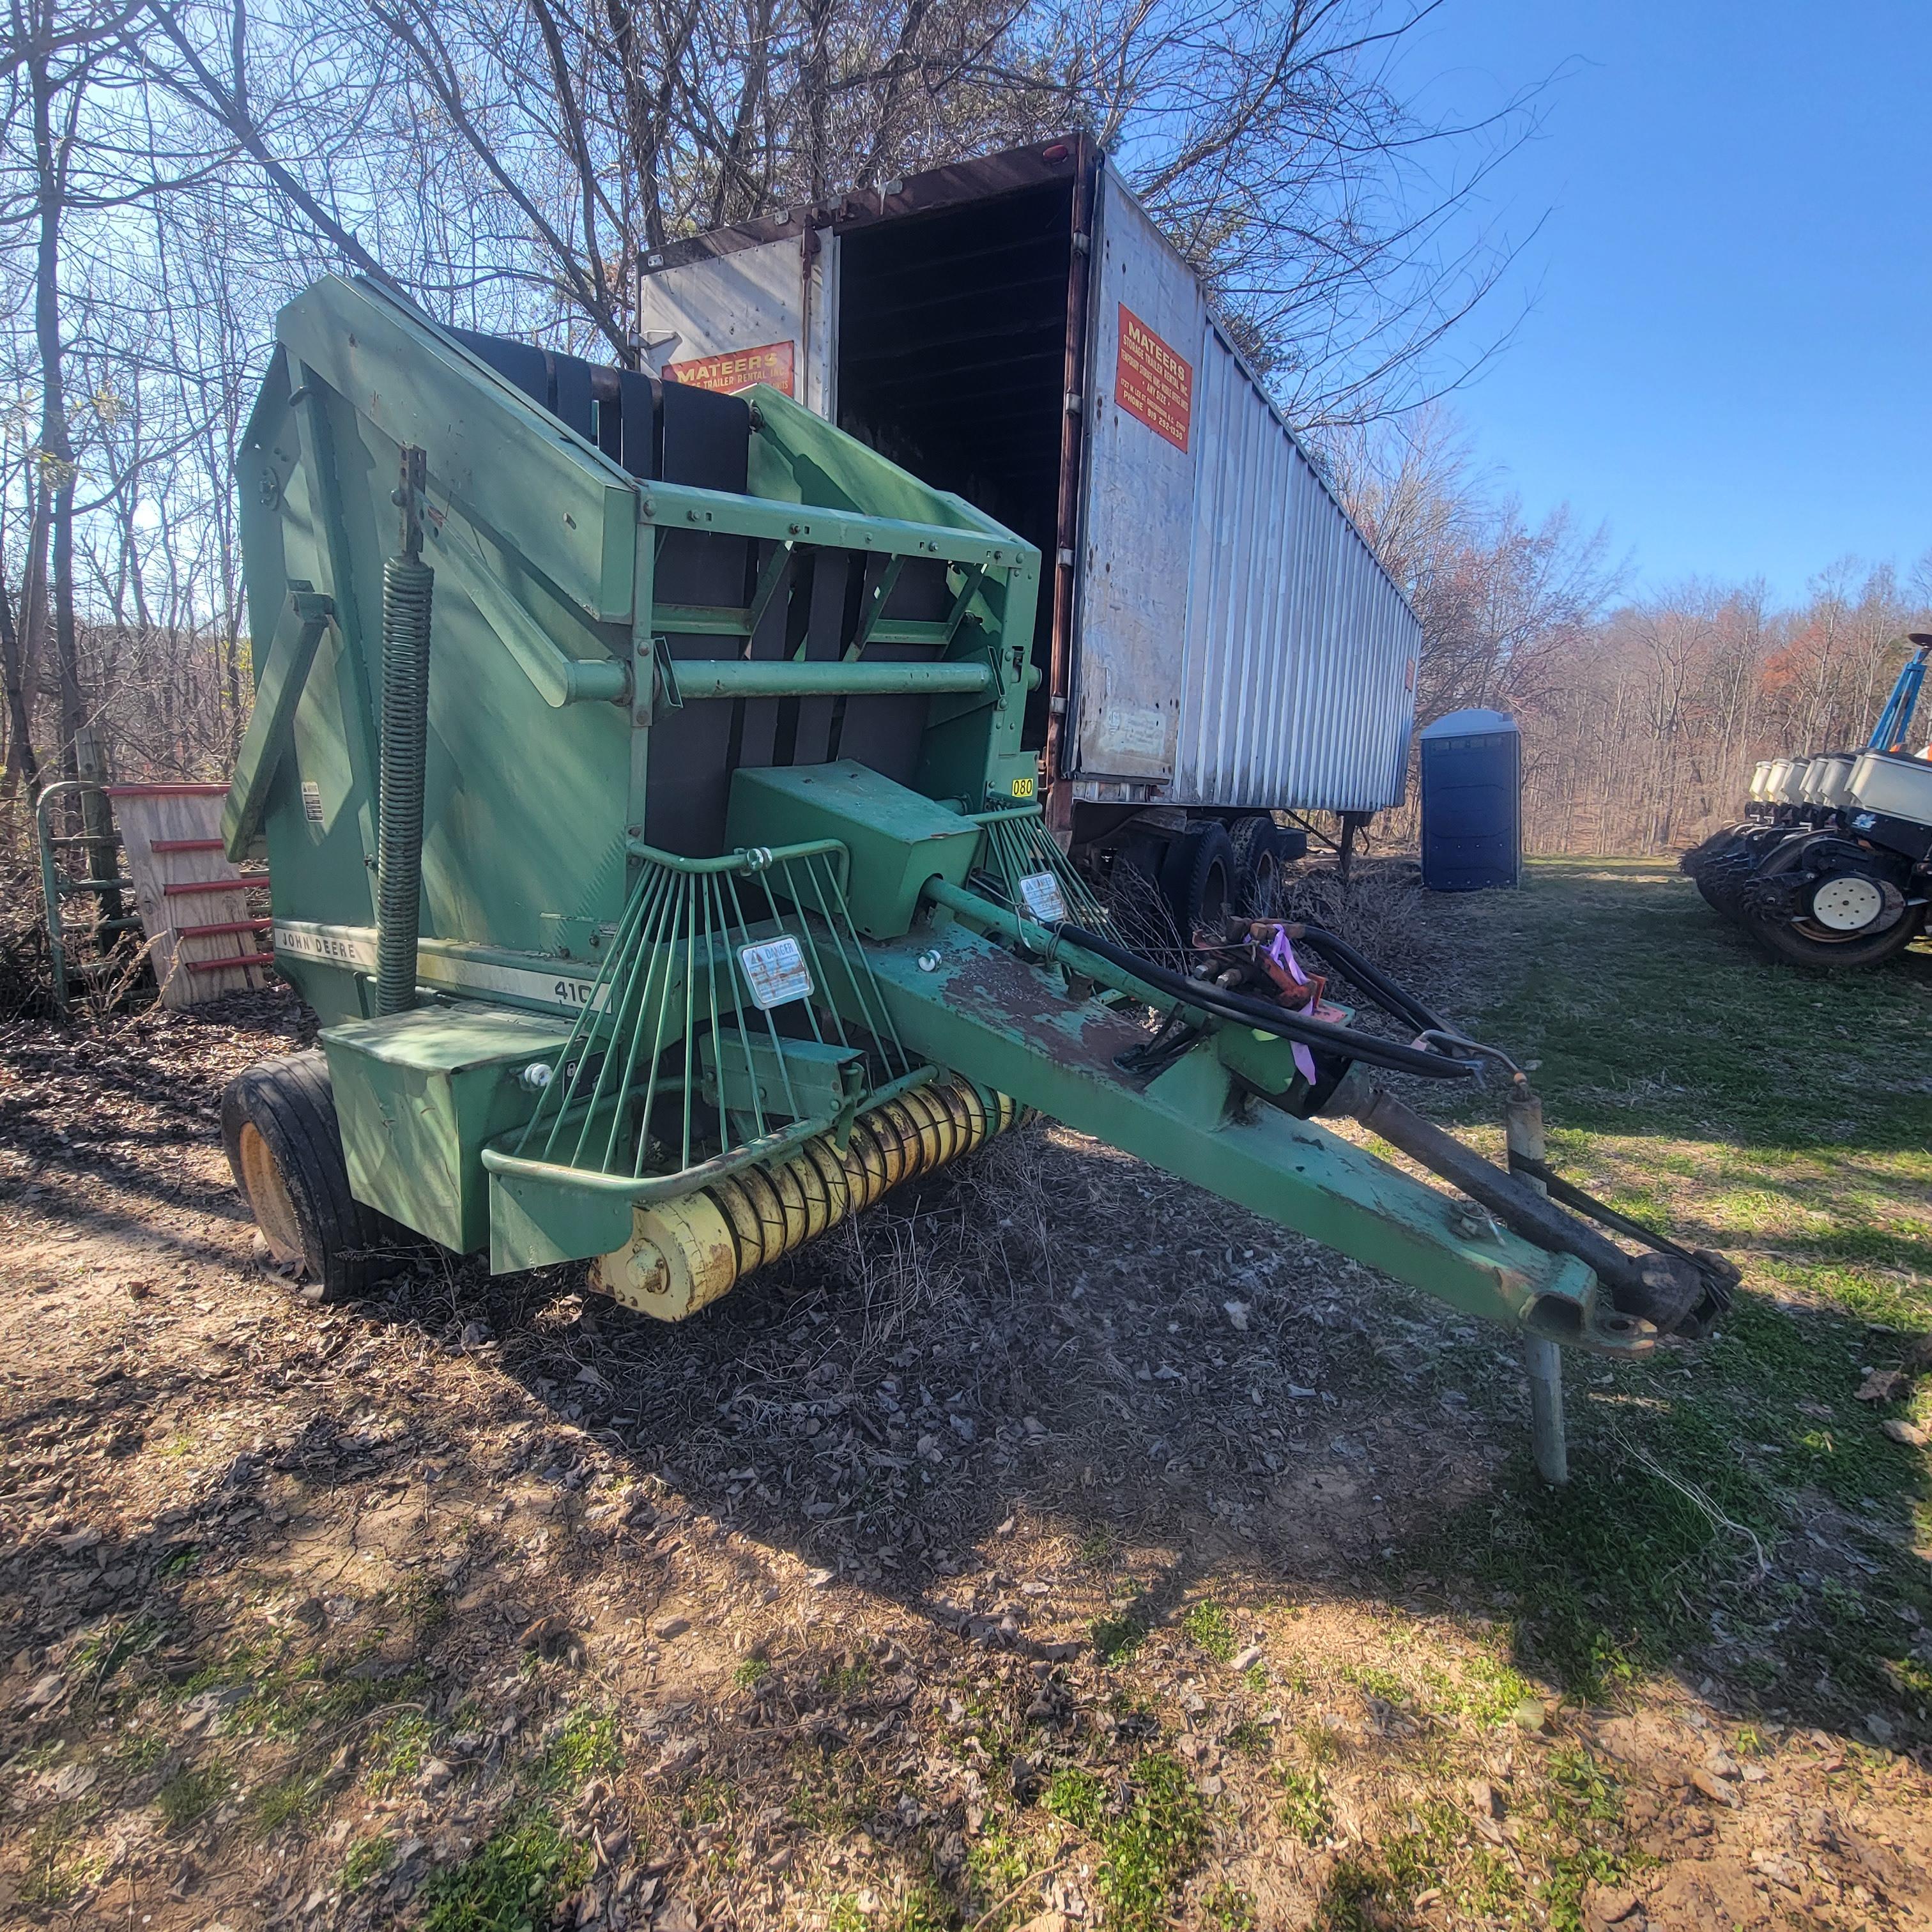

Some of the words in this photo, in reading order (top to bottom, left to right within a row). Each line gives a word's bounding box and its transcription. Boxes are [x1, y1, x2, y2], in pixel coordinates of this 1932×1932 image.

[1123, 334, 1144, 360] STORAGE
[1144, 353, 1163, 376] TRAILER
[1163, 370, 1179, 390] RENTAL
[1129, 321, 1185, 381] MATEERS
[678, 352, 778, 383] MATEERS
[703, 377, 733, 389] TRAILER
[738, 371, 765, 383] RENTAL
[1123, 390, 1144, 411] PHONE
[1147, 383, 1156, 396] ANY
[1156, 390, 1166, 405] SIZE
[1014, 779, 1032, 795] 080
[283, 933, 310, 950] JOHN
[315, 939, 355, 958] DEERE
[765, 942, 793, 960] DANGER
[555, 981, 592, 1004] 410
